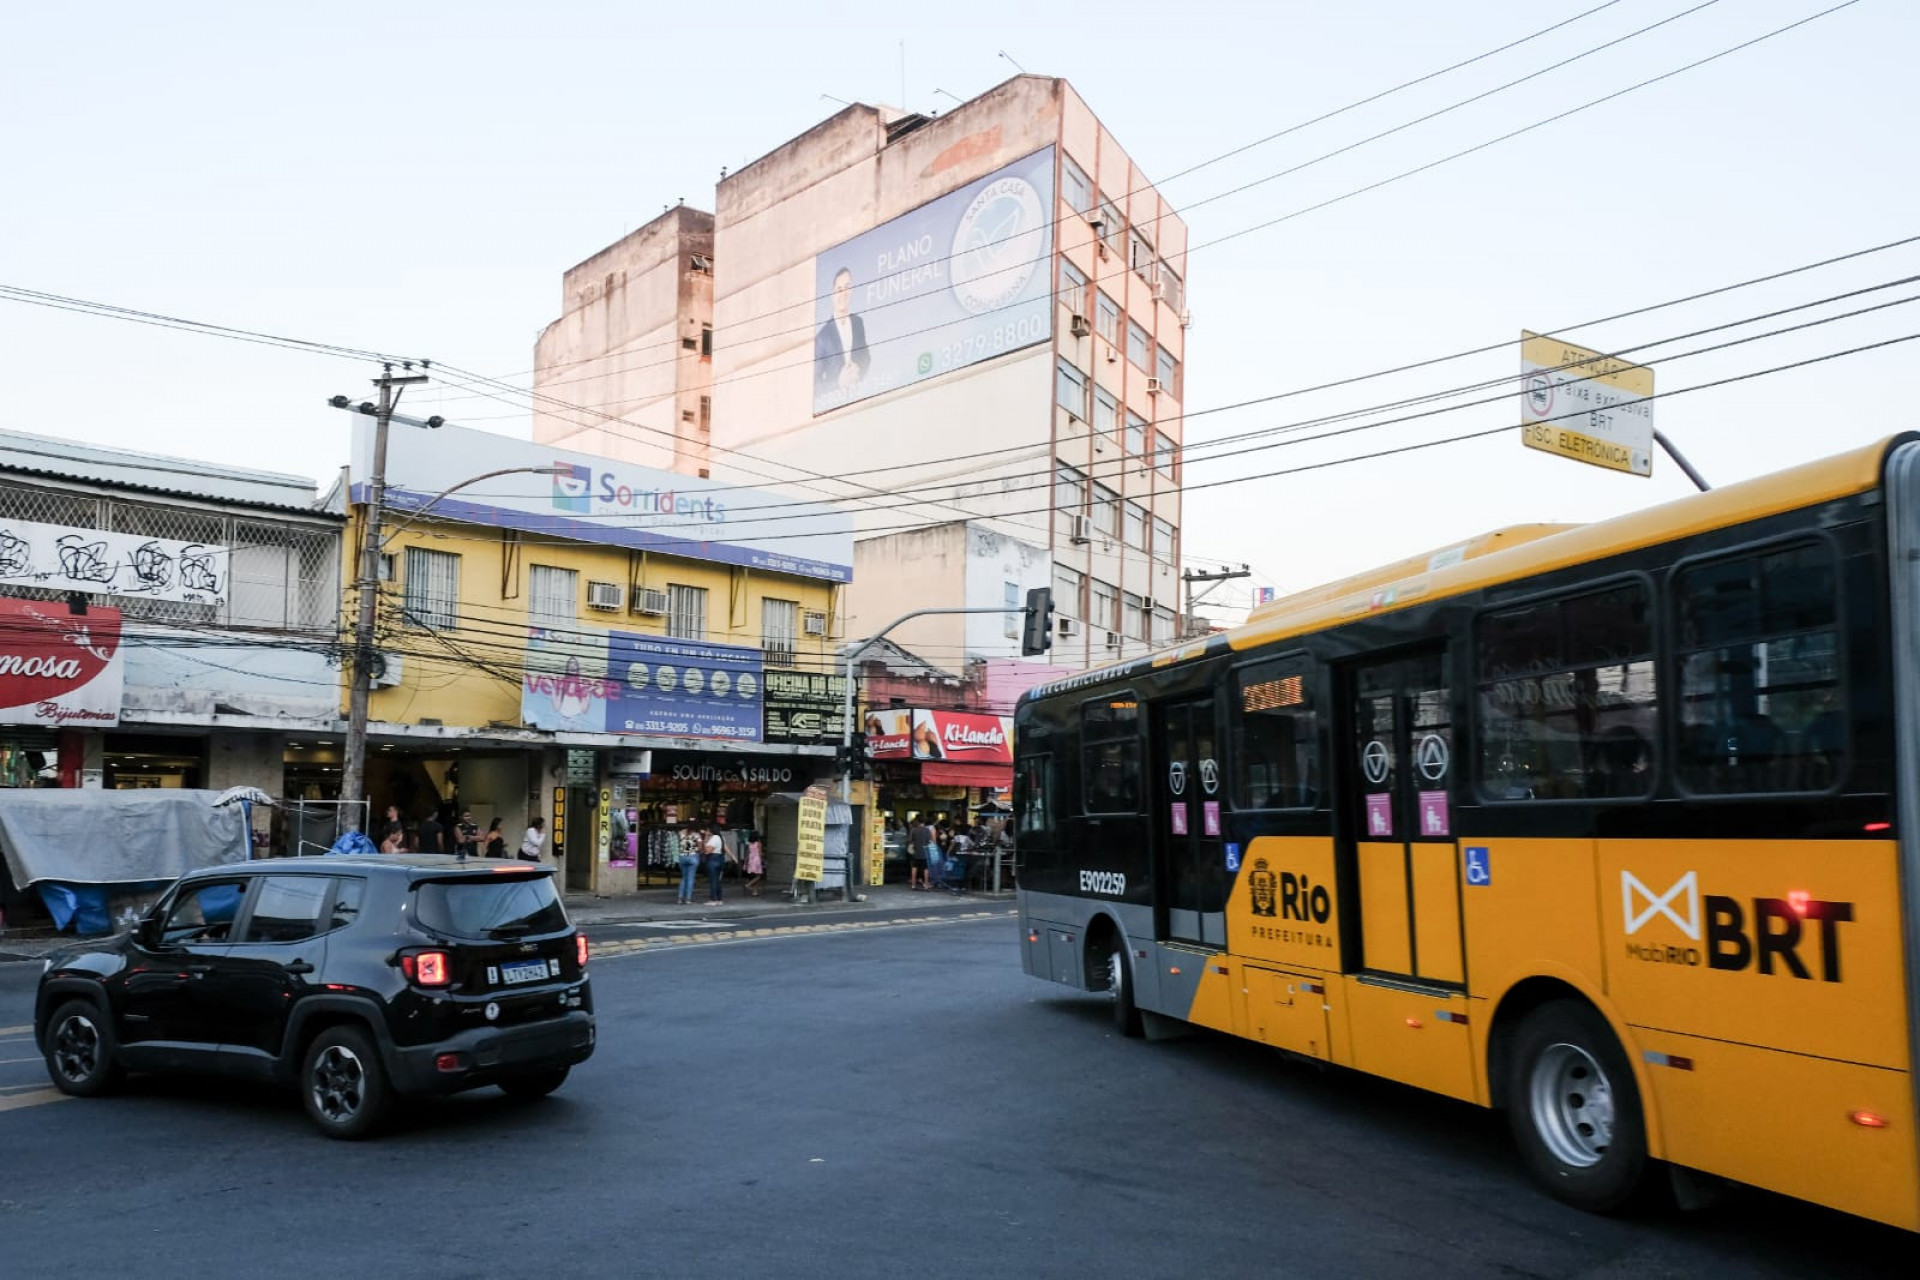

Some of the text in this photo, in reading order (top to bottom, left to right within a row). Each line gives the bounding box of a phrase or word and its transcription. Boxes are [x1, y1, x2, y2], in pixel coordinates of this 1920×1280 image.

[966, 180, 1027, 222] SANTA CASA
[877, 234, 932, 274] PLANO
[866, 259, 943, 304] FUNERAL
[1589, 412, 1614, 431] BRT
[600, 473, 726, 524] Sorridents
[1054, 664, 1132, 693] CONDICIONADO
[35, 701, 116, 723] Bijuterias
[944, 723, 1004, 745] Ki-Lanche
[749, 768, 792, 782] SALDO
[555, 788, 564, 845] OURO
[601, 791, 610, 846] OURO
[1079, 870, 1126, 895] E902259
[1281, 872, 1331, 924] Rio
[1252, 926, 1333, 948] PREFEITURA
[1703, 894, 1855, 984] BRT
